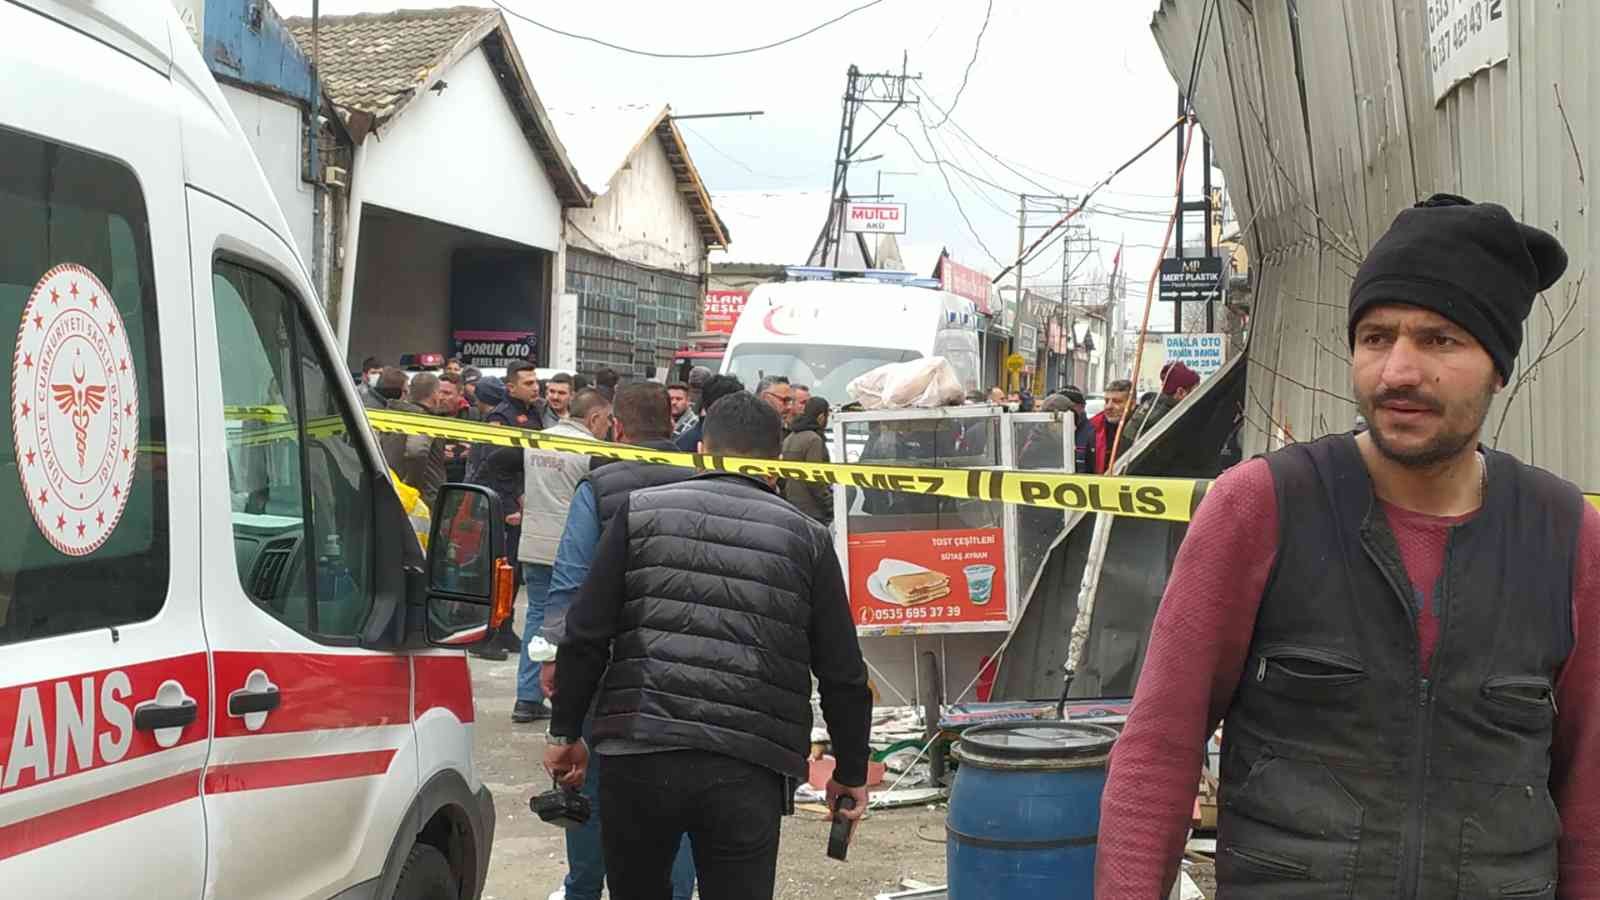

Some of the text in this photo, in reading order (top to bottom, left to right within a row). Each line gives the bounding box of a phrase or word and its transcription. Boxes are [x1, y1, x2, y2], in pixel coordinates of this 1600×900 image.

[851, 207, 899, 221] MUTLU
[1162, 273, 1184, 281] MERT
[1200, 337, 1221, 347] OTO
[463, 342, 530, 357] DORUK OTO
[1020, 480, 1167, 515] POLİS
[931, 535, 996, 548] TOST ÇEŞİTLERİ
[964, 551, 988, 560] AYRAN
[875, 607, 904, 620] 0535
[905, 607, 927, 619] 695
[929, 606, 944, 617] 37
[0, 670, 134, 789] ANS
